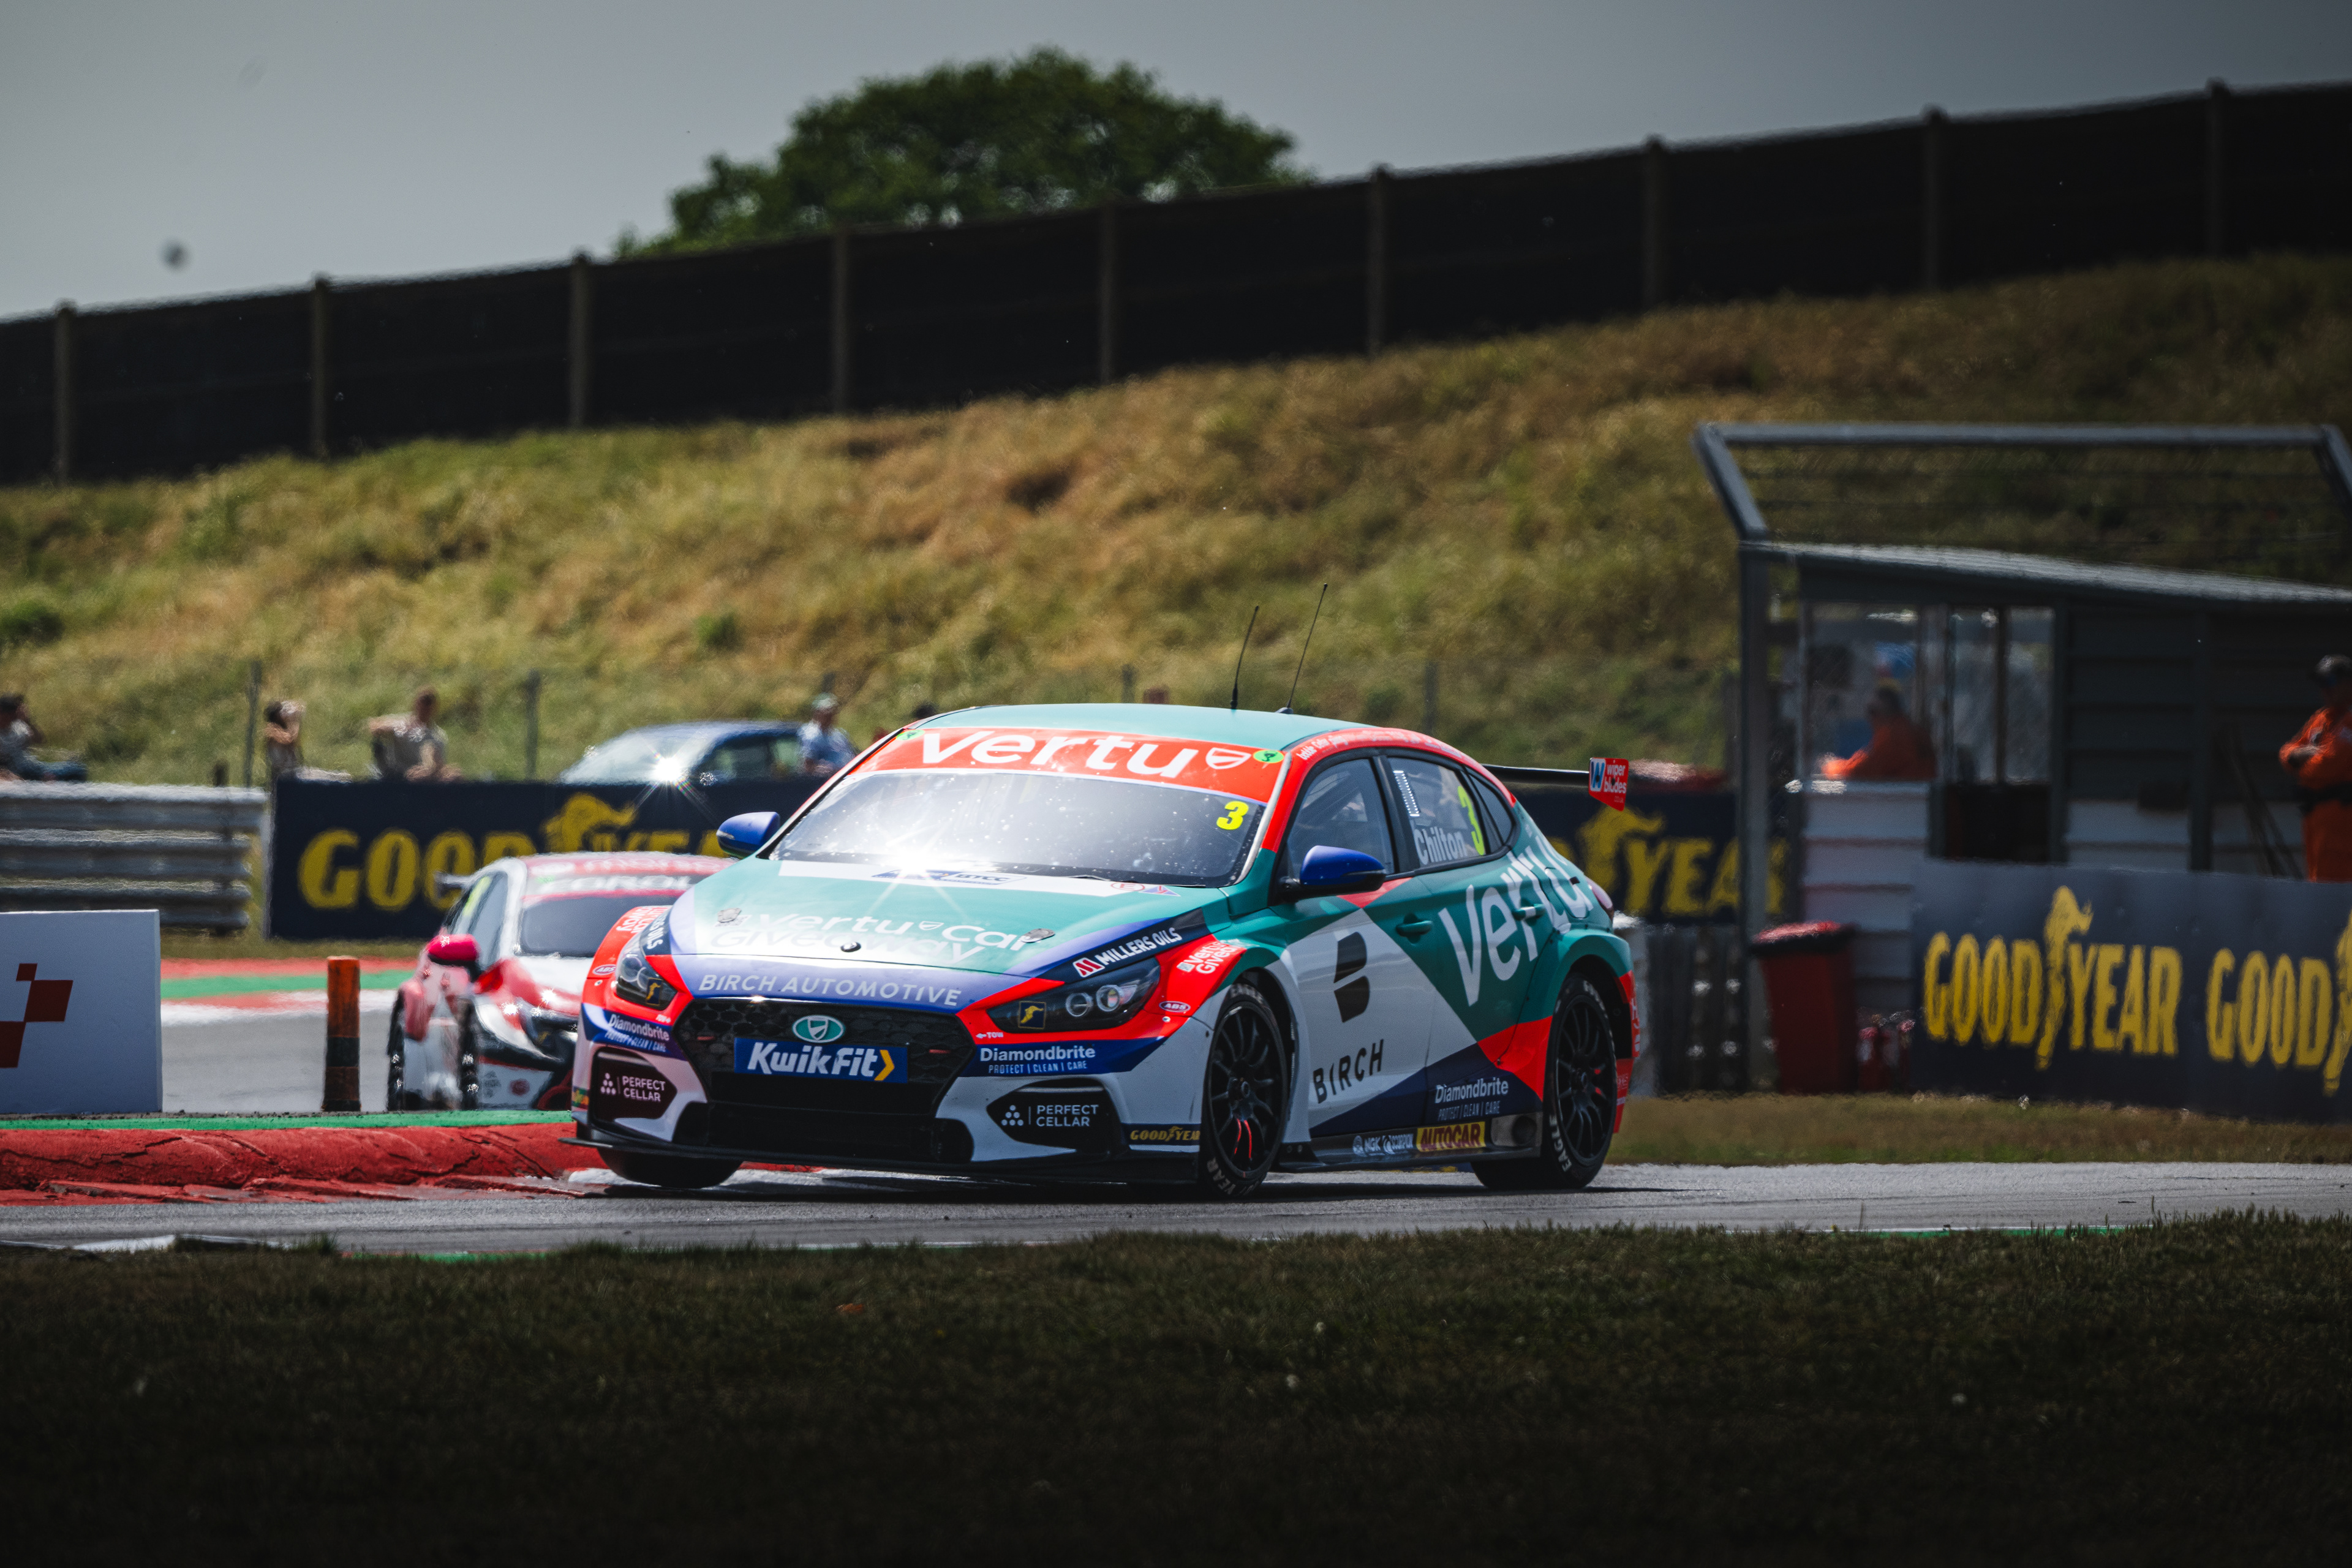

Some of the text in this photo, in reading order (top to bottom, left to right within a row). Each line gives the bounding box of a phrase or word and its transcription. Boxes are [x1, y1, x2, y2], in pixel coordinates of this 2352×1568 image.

[922, 729, 1199, 778] Vertu
[1216, 801, 1249, 830] 3
[1457, 785, 1485, 856] 3
[1414, 826, 1468, 865] Chilton
[760, 913, 907, 935] Vertu
[1438, 835, 1594, 1007] Vertu
[1095, 927, 1183, 965] MILLERS OILS
[698, 974, 962, 1006] BIRCH AUTOMOTIVE
[608, 1014, 669, 1041] Diamondbrite
[980, 1046, 1096, 1061] Diamondbrite
[989, 1061, 1087, 1074] PROTECT CLEAN CARE
[622, 1076, 666, 1091] PERFECT
[1313, 1039, 1384, 1104] BIRCH
[624, 1088, 661, 1102] CELLAR
[1434, 1077, 1509, 1103] Diamondbrite
[1036, 1104, 1099, 1115] PERFECT
[1036, 1117, 1090, 1126] CELLAR
[1420, 1123, 1481, 1152] AUTOCAR
